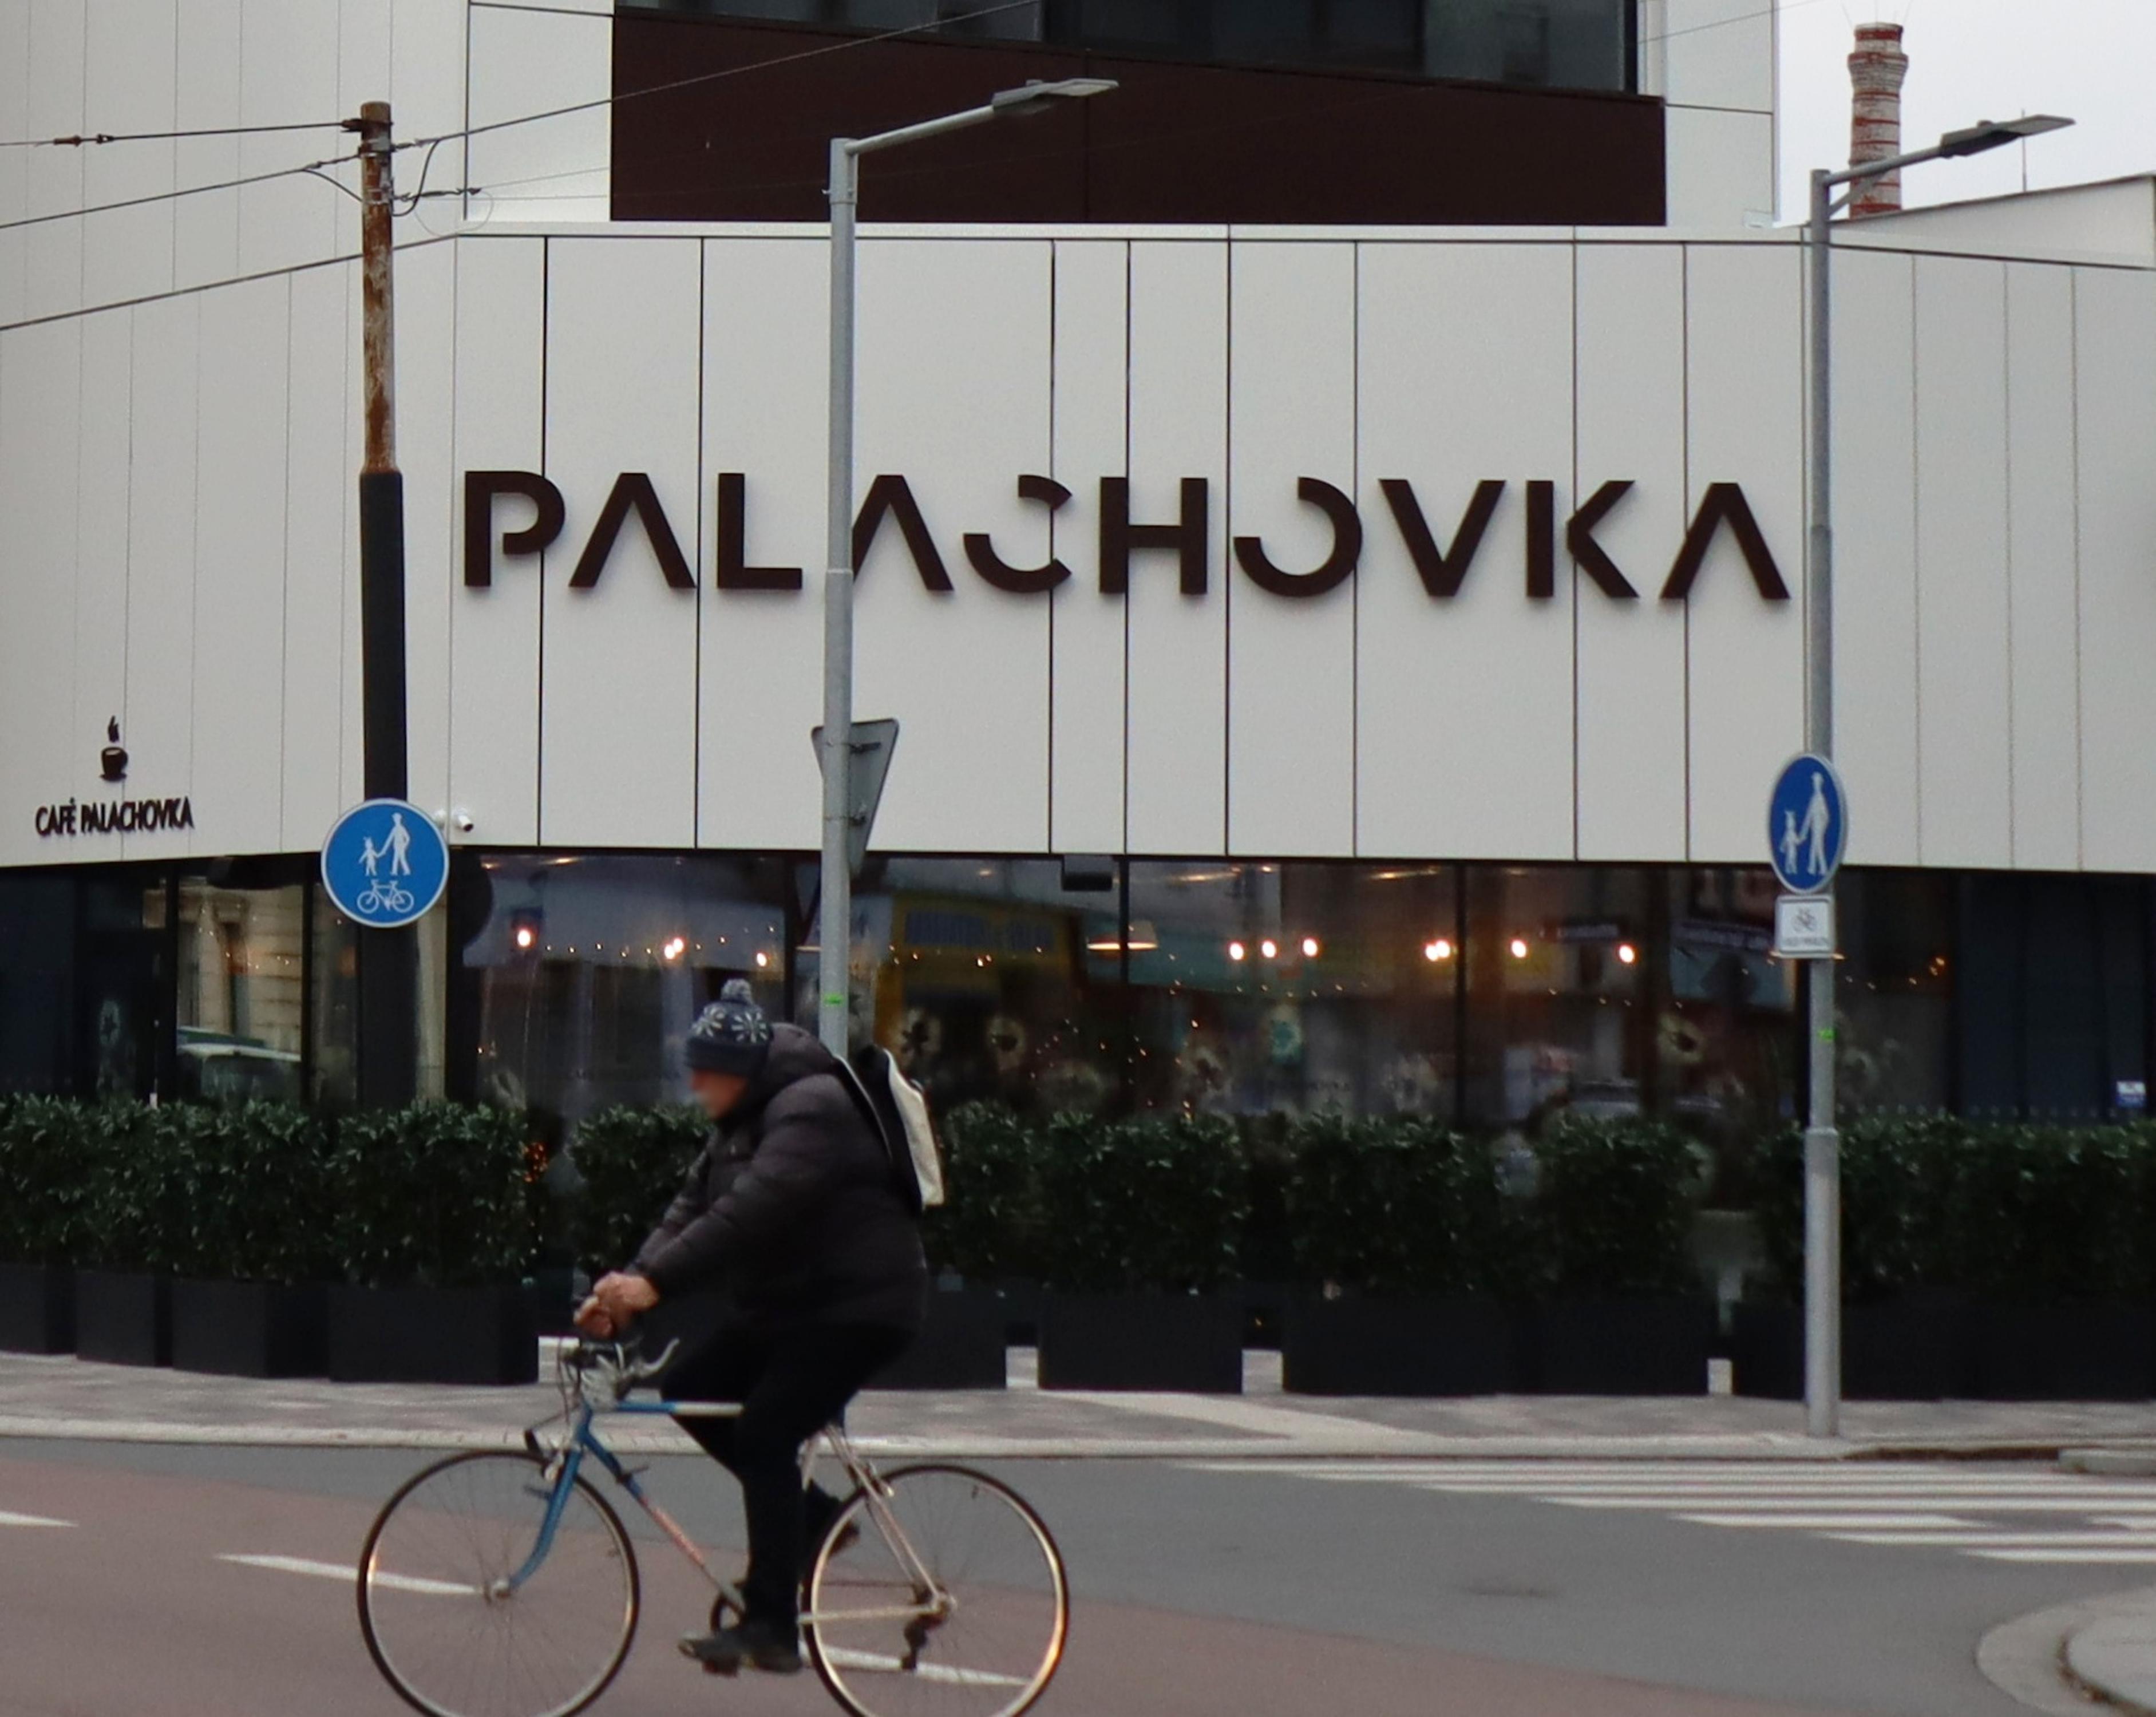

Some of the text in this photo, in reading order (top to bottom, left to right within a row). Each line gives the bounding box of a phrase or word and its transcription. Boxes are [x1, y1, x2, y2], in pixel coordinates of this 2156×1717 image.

[465, 471, 1790, 599] PALACHOVKA
[35, 796, 194, 836] CAFÉ PALACHOVKA
